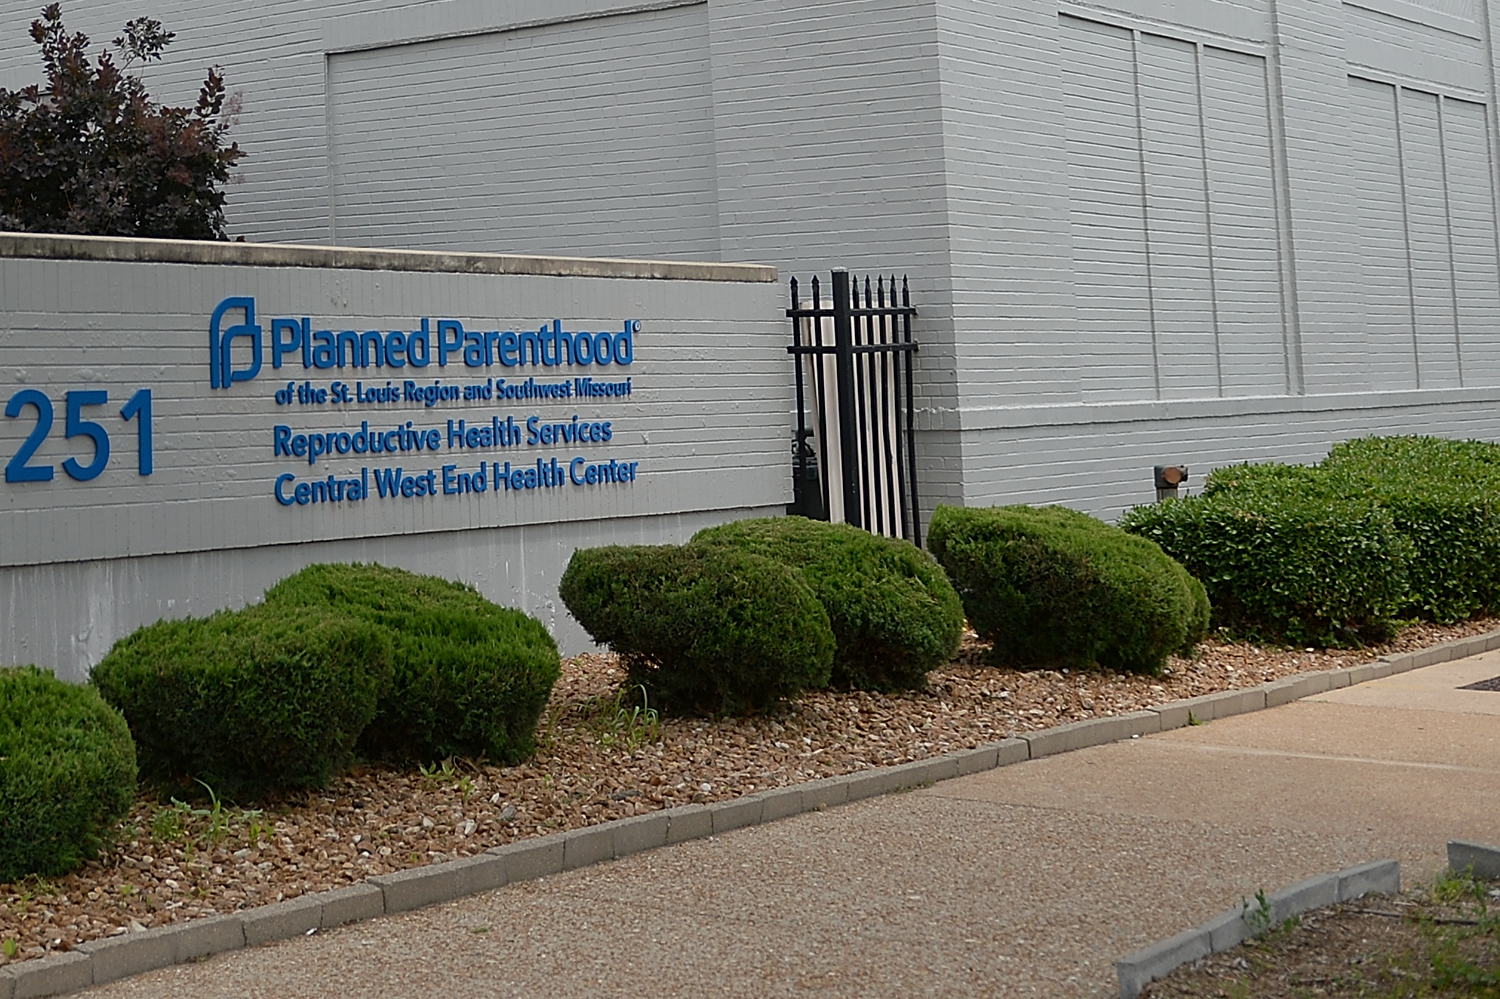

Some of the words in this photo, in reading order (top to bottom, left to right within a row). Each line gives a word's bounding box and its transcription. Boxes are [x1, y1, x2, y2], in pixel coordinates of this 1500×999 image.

[271, 317, 430, 370] Planned
[275, 381, 295, 405] of
[298, 381, 328, 404] the
[331, 381, 353, 403] St.
[356, 381, 400, 403] Louis
[403, 380, 460, 407] Region
[464, 378, 493, 400] and
[497, 377, 572, 399] Southwest
[575, 377, 632, 398] Missouri
[273, 420, 441, 465] Reproductive
[447, 415, 522, 448] Health
[526, 414, 613, 445] Services
[274, 467, 369, 506] Central
[373, 467, 437, 498] West
[442, 461, 488, 494] End
[493, 457, 566, 491] Health
[569, 456, 639, 486] Center
